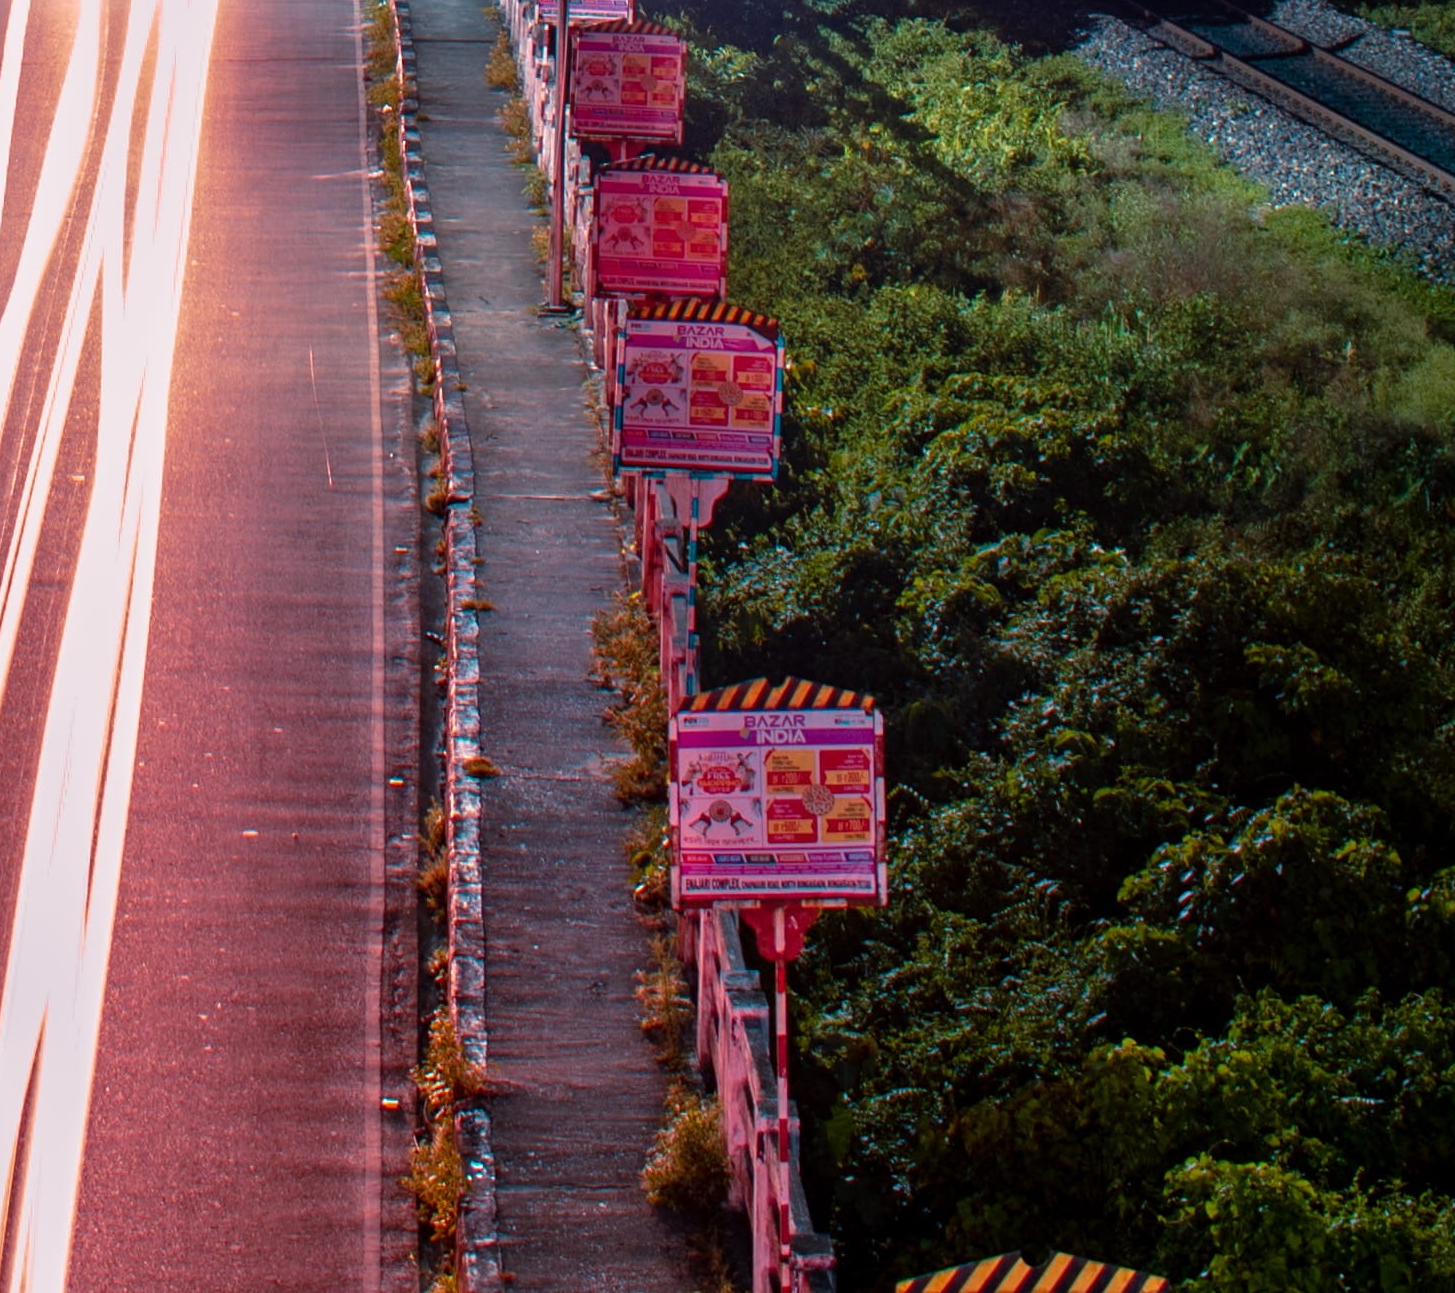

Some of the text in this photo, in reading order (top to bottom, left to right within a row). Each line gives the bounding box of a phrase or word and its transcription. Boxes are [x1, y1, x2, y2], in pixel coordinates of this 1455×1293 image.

[642, 175, 681, 184] BAZAR
[649, 184, 680, 194] INDIA
[677, 325, 725, 337] BAZAR
[685, 336, 724, 348] INDIA
[744, 715, 805, 728] BAZAR
[756, 729, 806, 744] INDIA
